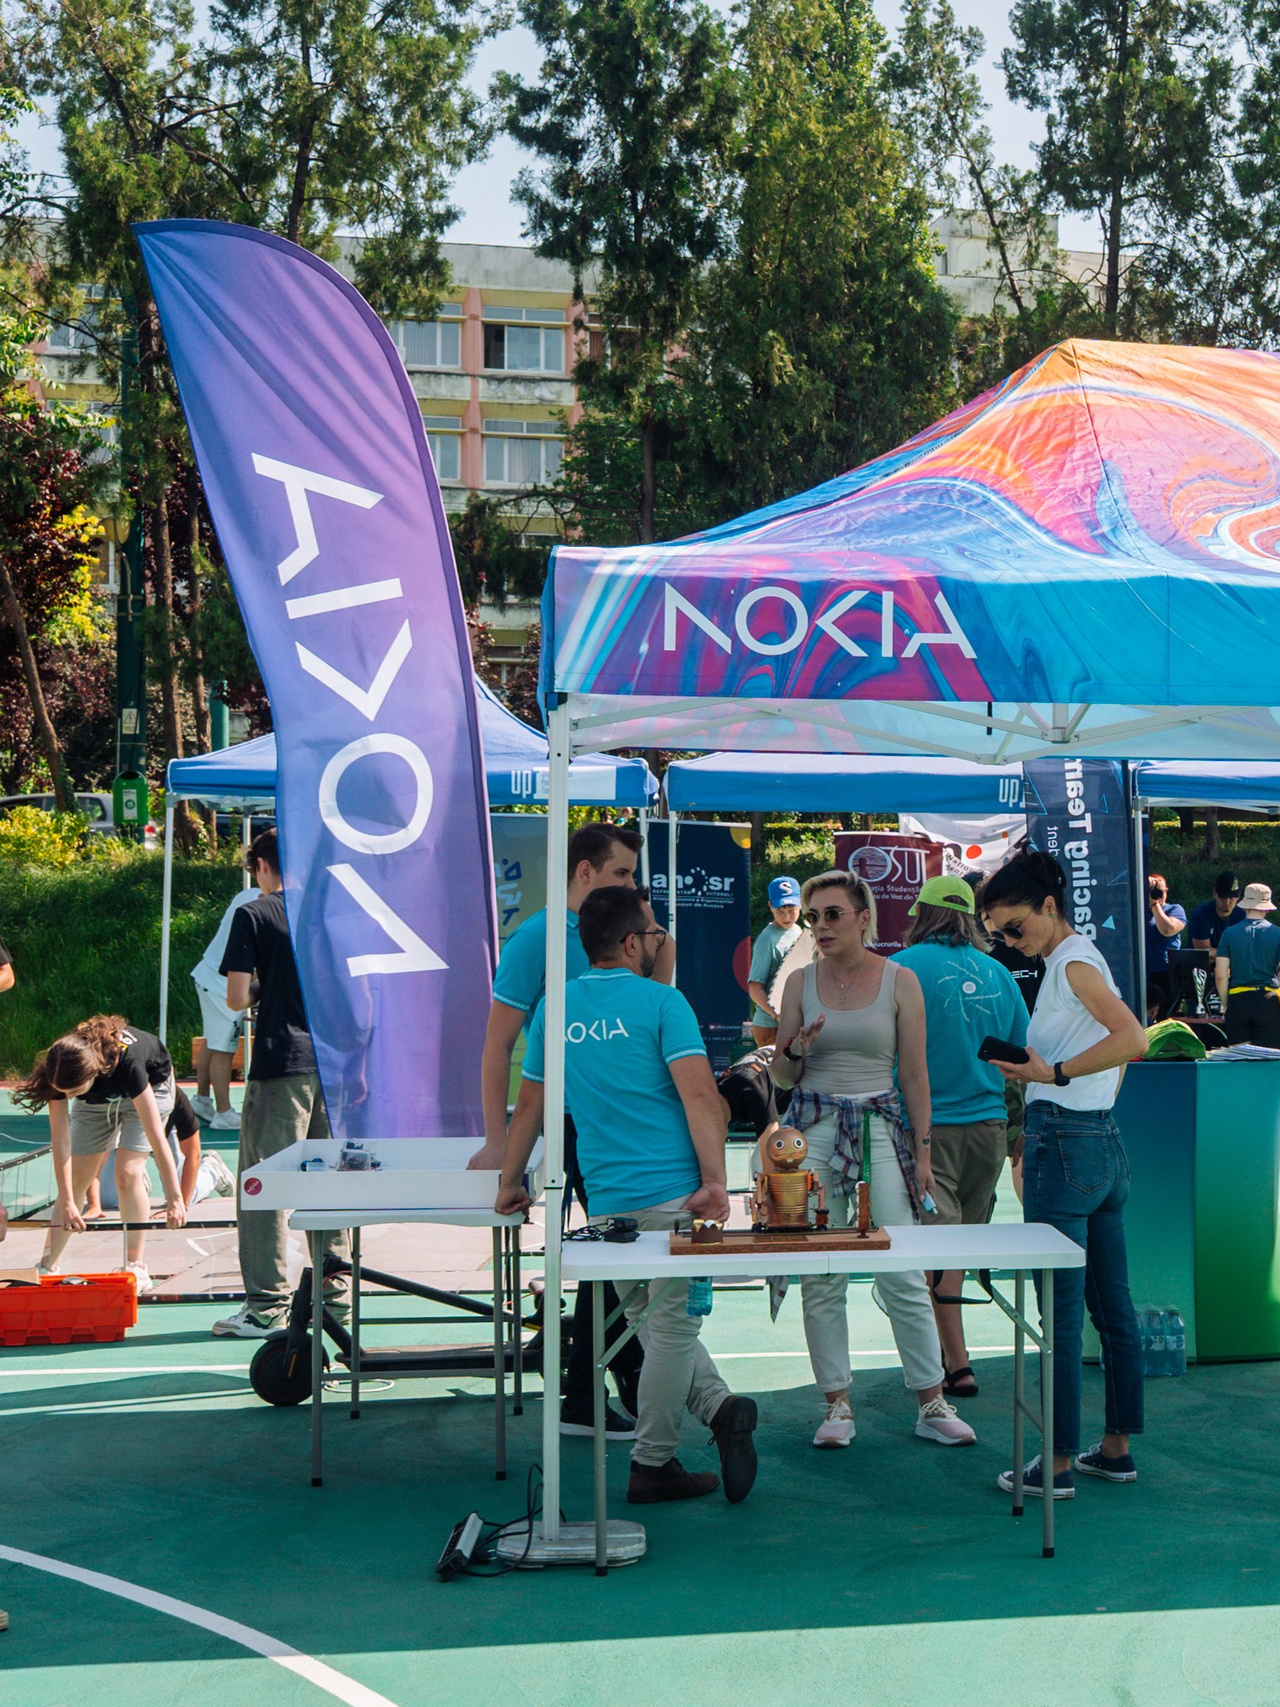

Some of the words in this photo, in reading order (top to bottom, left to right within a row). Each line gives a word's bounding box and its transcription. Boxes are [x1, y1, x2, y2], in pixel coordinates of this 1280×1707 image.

[663, 581, 978, 660] NOKIA
[779, 881, 793, 896] S
[565, 1016, 629, 1044] OKIA
